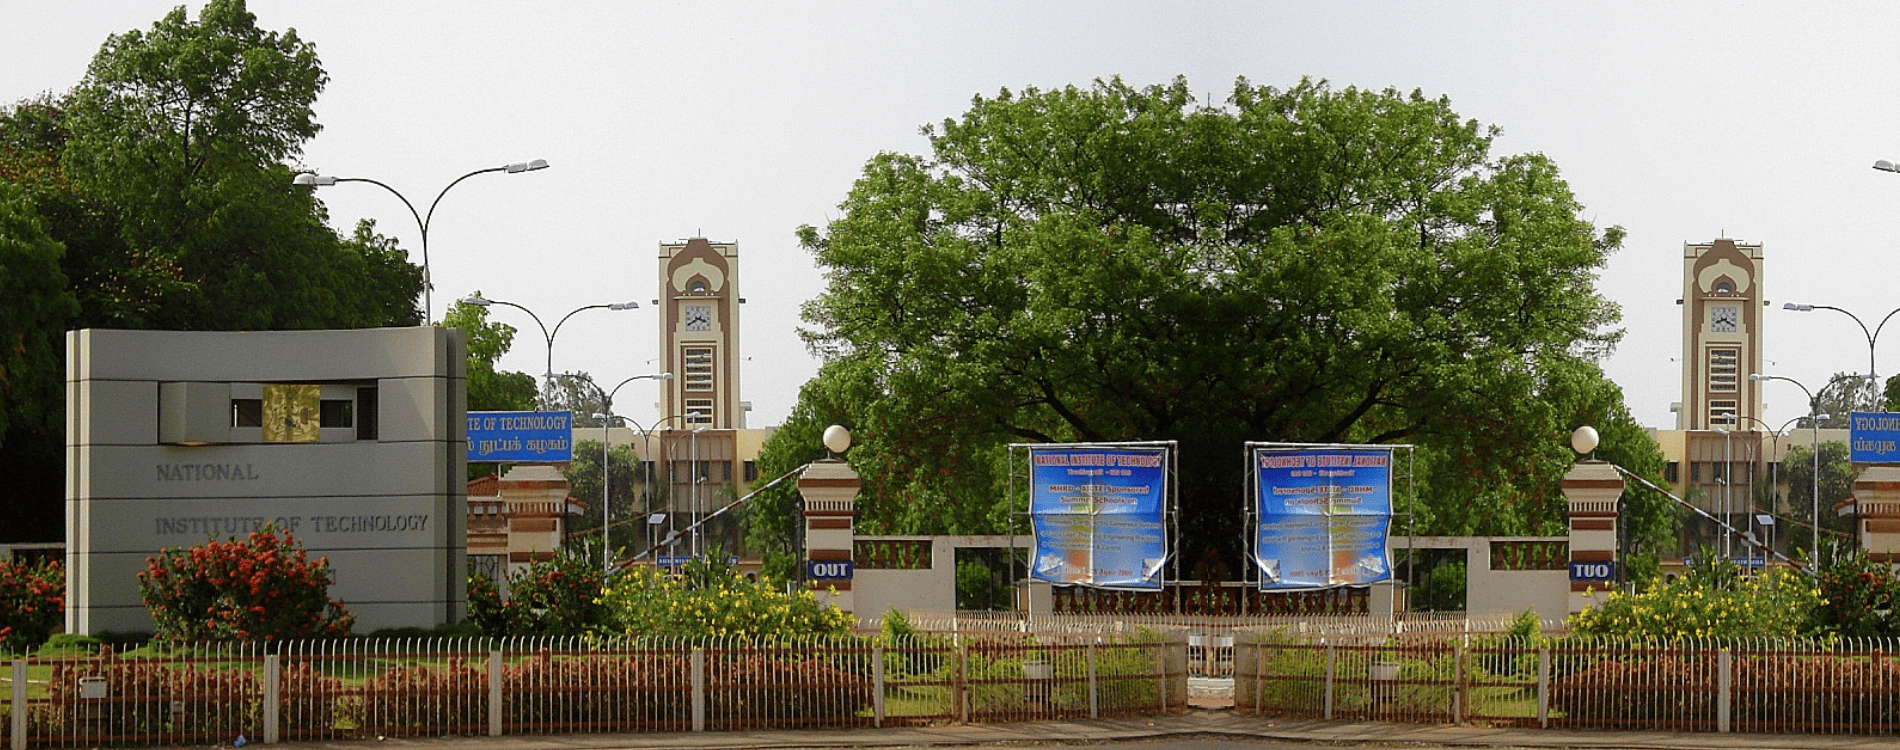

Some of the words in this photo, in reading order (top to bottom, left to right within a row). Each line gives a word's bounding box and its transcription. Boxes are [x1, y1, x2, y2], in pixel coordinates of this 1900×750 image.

[483, 417, 497, 431] OF
[500, 416, 567, 431] TECHNOLOGY
[526, 435, 569, 454] கழகம்
[1036, 454, 1069, 466] NATIONAL
[1071, 454, 1105, 466] INSTITUTE
[1106, 454, 1116, 466] OF
[1117, 454, 1162, 467] TECHNOLOGY
[156, 464, 259, 481] NATIONAL
[1049, 485, 1074, 493] MHRD
[1105, 485, 1150, 495] Sponsored
[1094, 496, 1126, 504] Schools
[155, 516, 264, 535] INSTITUTE
[274, 516, 301, 534] OF
[311, 514, 428, 533] TECHNOLOGY
[813, 563, 848, 577] OUT
